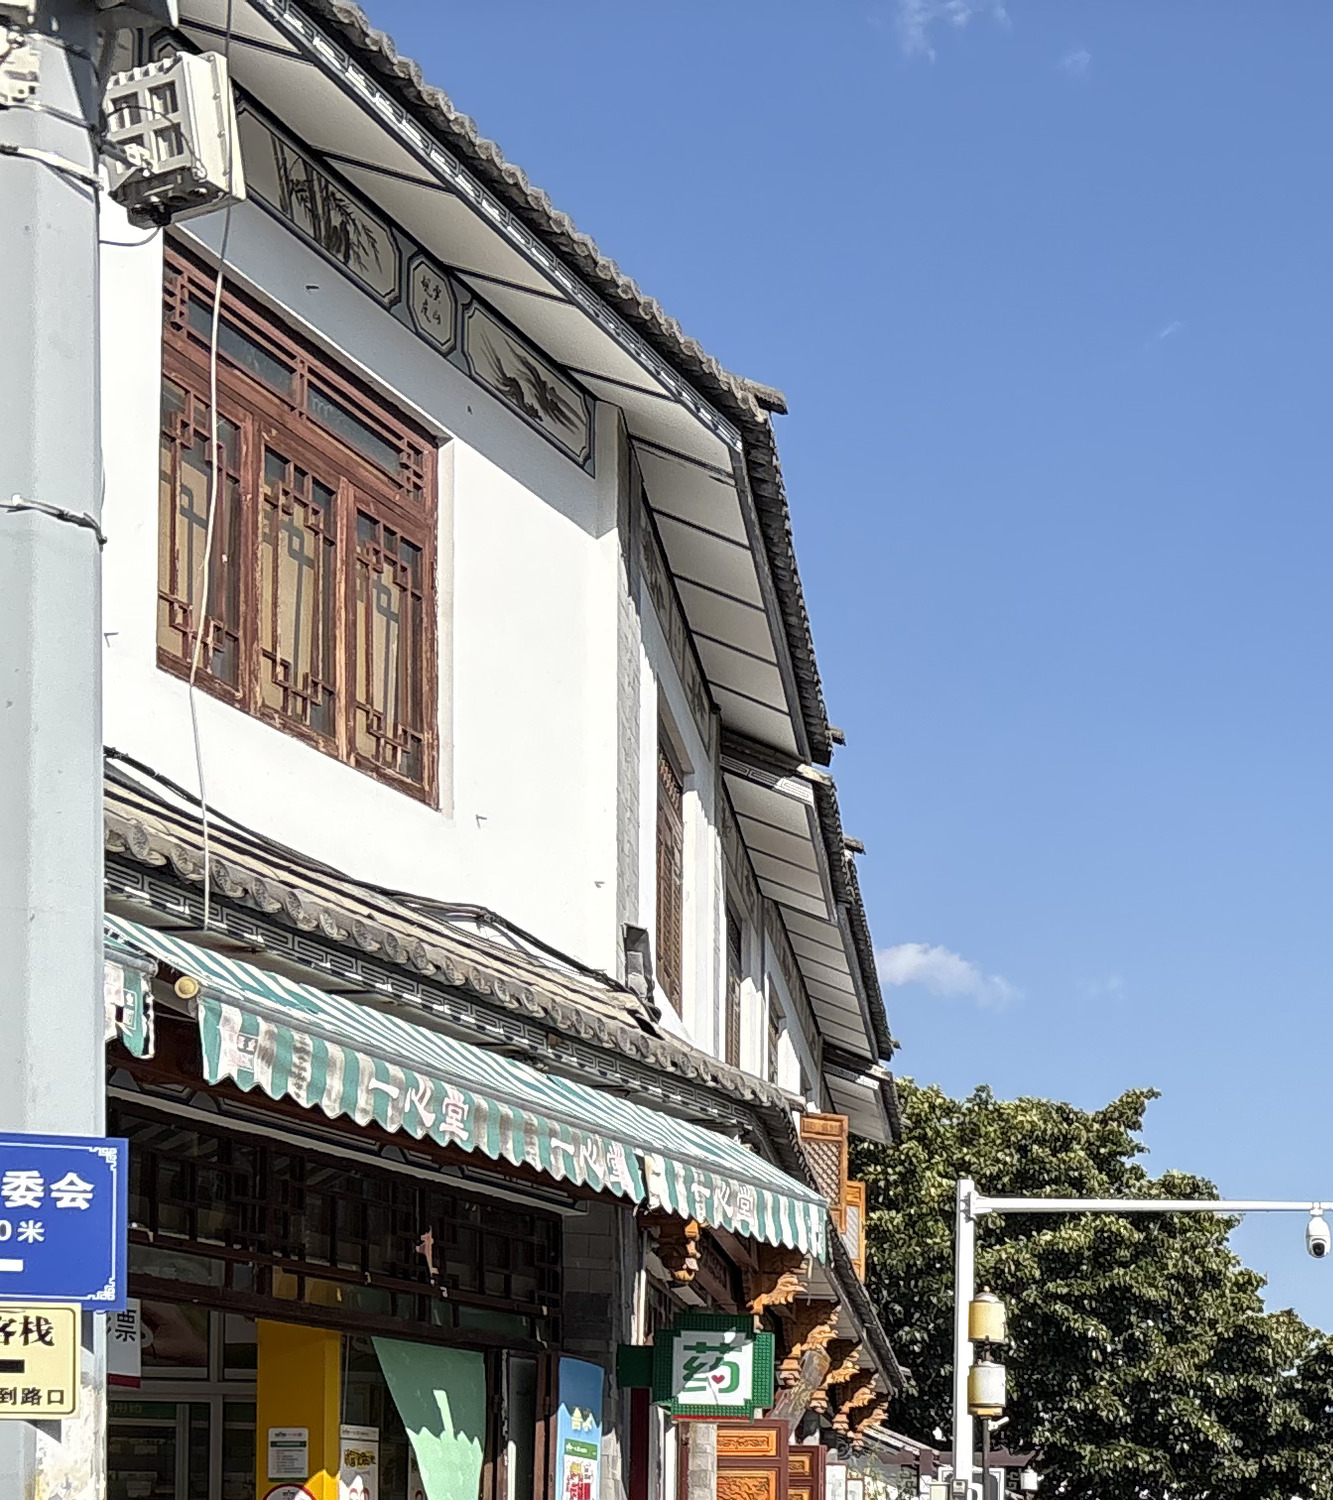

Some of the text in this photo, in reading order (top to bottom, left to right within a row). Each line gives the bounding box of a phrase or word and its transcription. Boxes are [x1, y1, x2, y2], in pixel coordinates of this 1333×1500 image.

[368, 1077, 469, 1140] 一心堂
[551, 1137, 626, 1183] 一心堂
[0, 1170, 96, 1211] 委会
[691, 1182, 757, 1221] 一心堂
[683, 1341, 741, 1394] 药
[0, 1386, 65, 1406] 到路口
